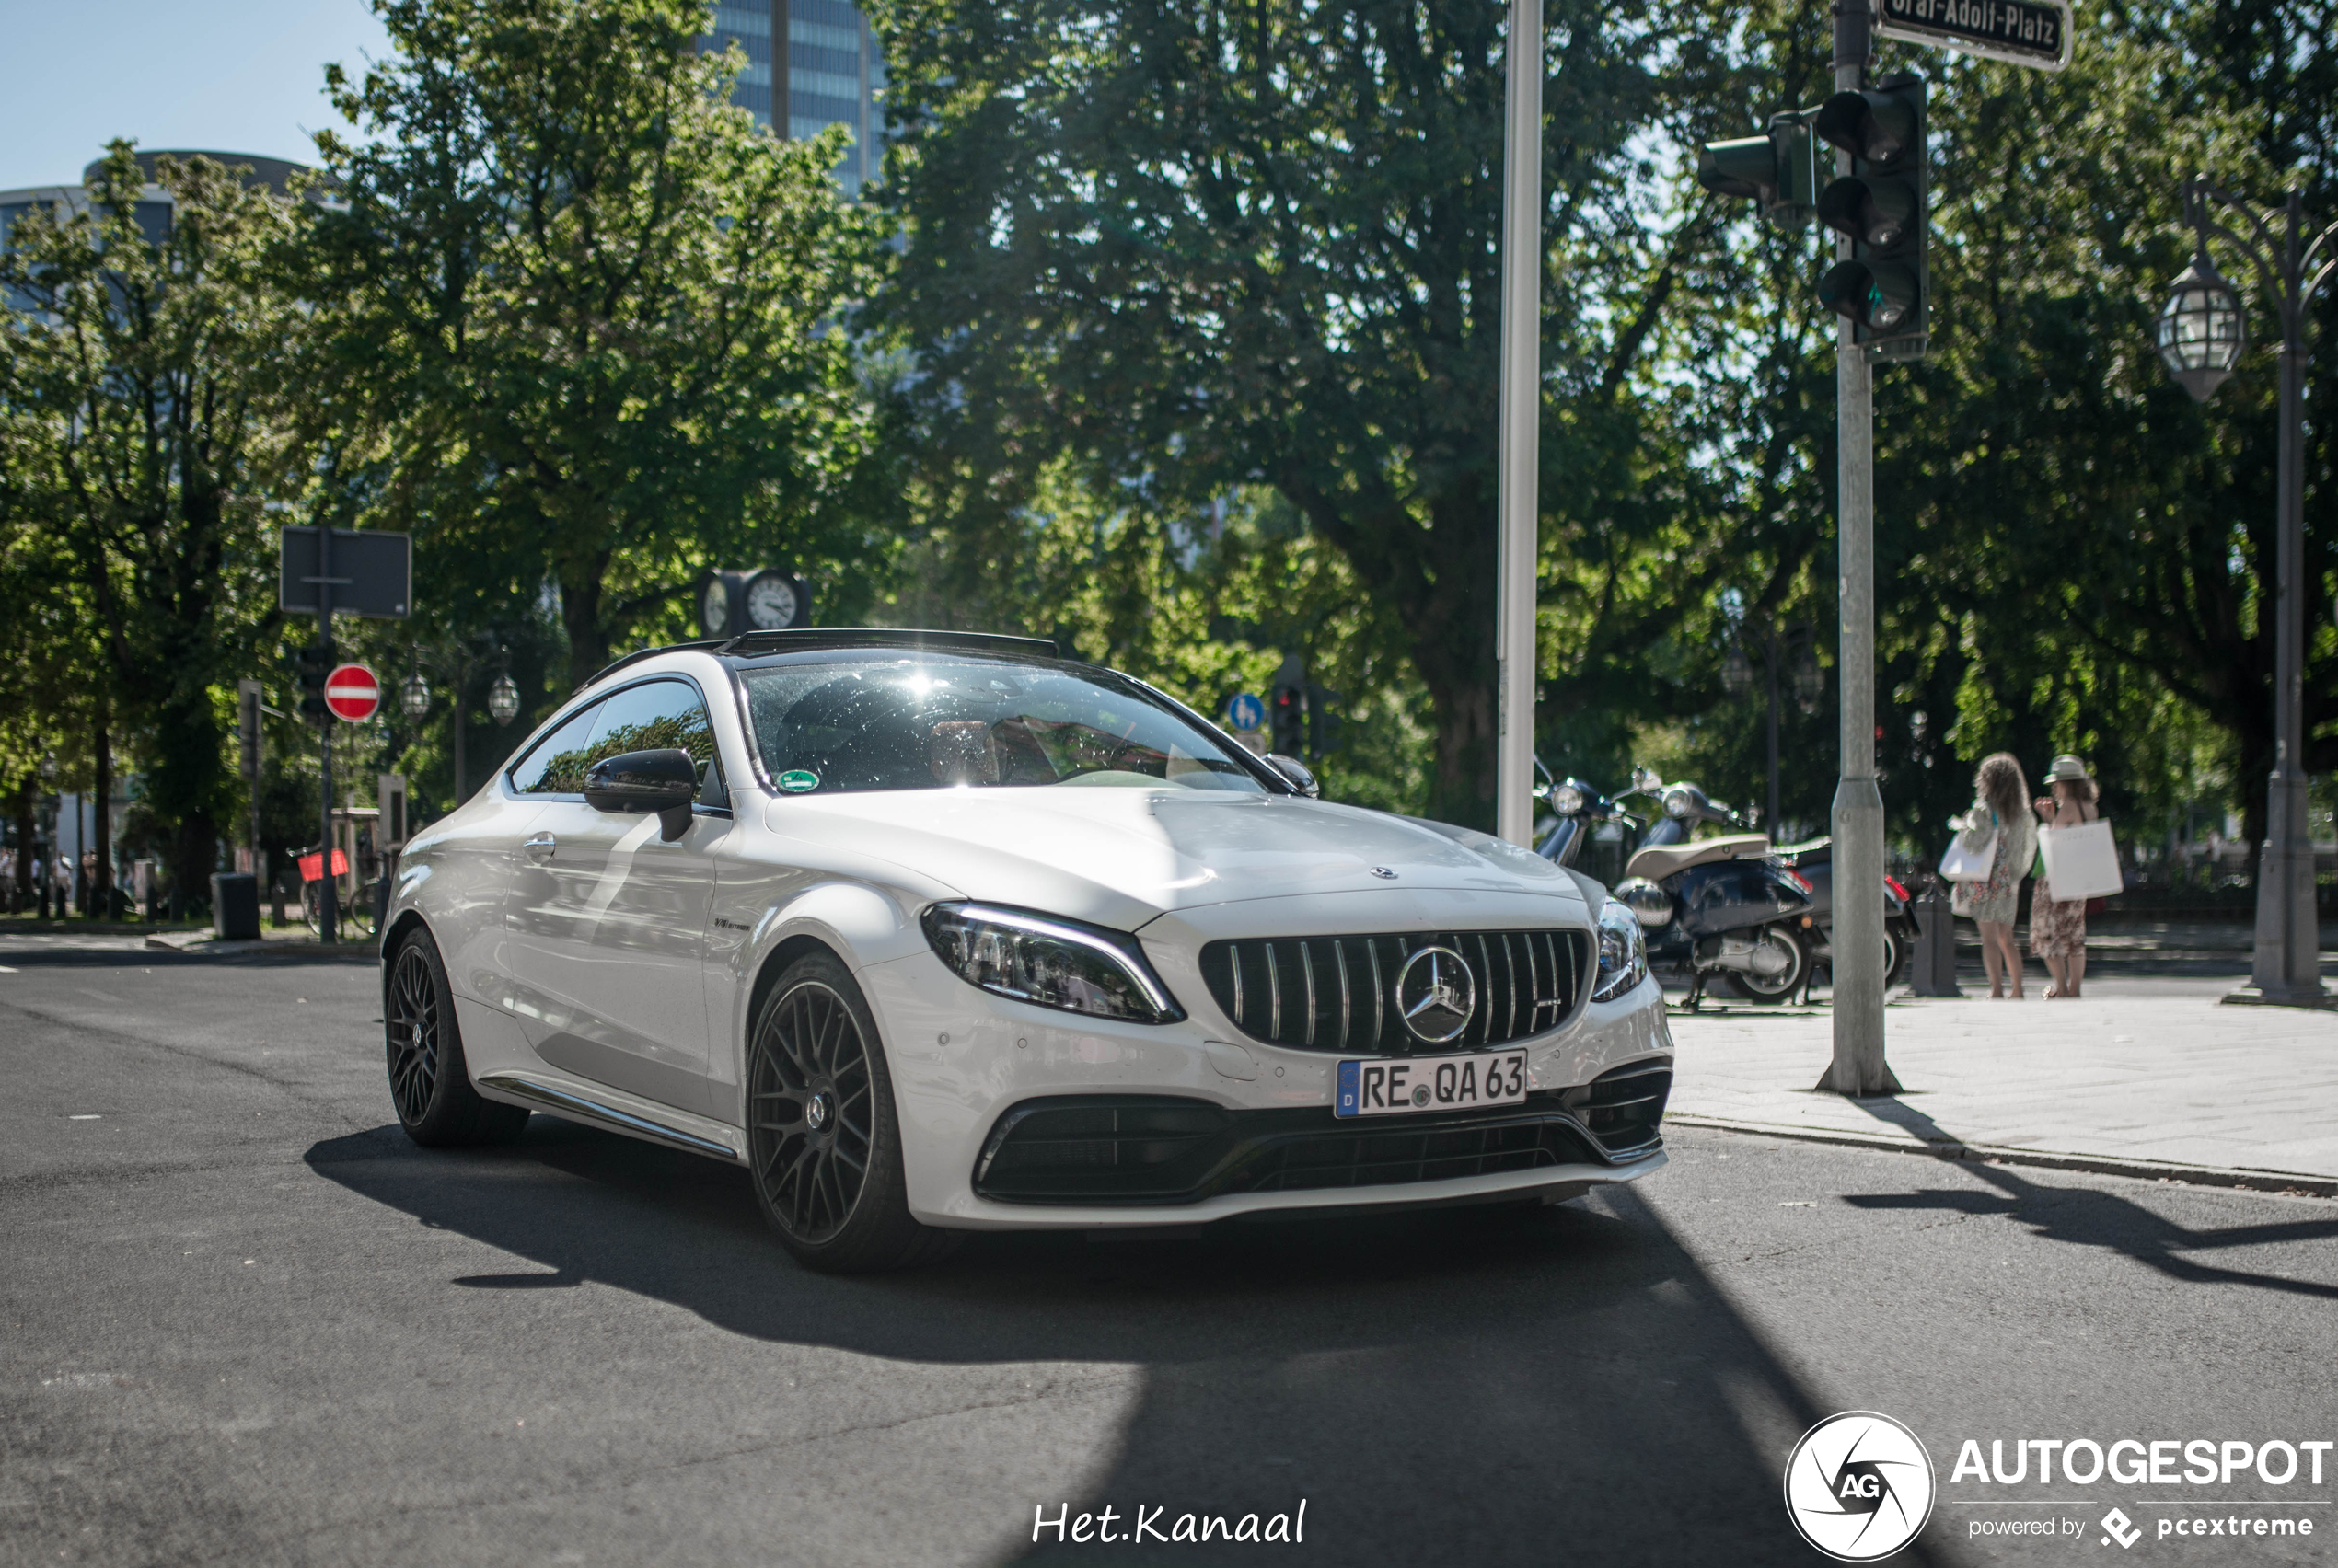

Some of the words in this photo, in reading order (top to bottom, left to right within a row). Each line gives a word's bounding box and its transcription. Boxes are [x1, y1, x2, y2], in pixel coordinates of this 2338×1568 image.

[1363, 1066, 1410, 1108] RE
[1436, 1061, 1477, 1103] QA
[1486, 1056, 1522, 1099] 63
[1344, 1095, 1353, 1107] D
